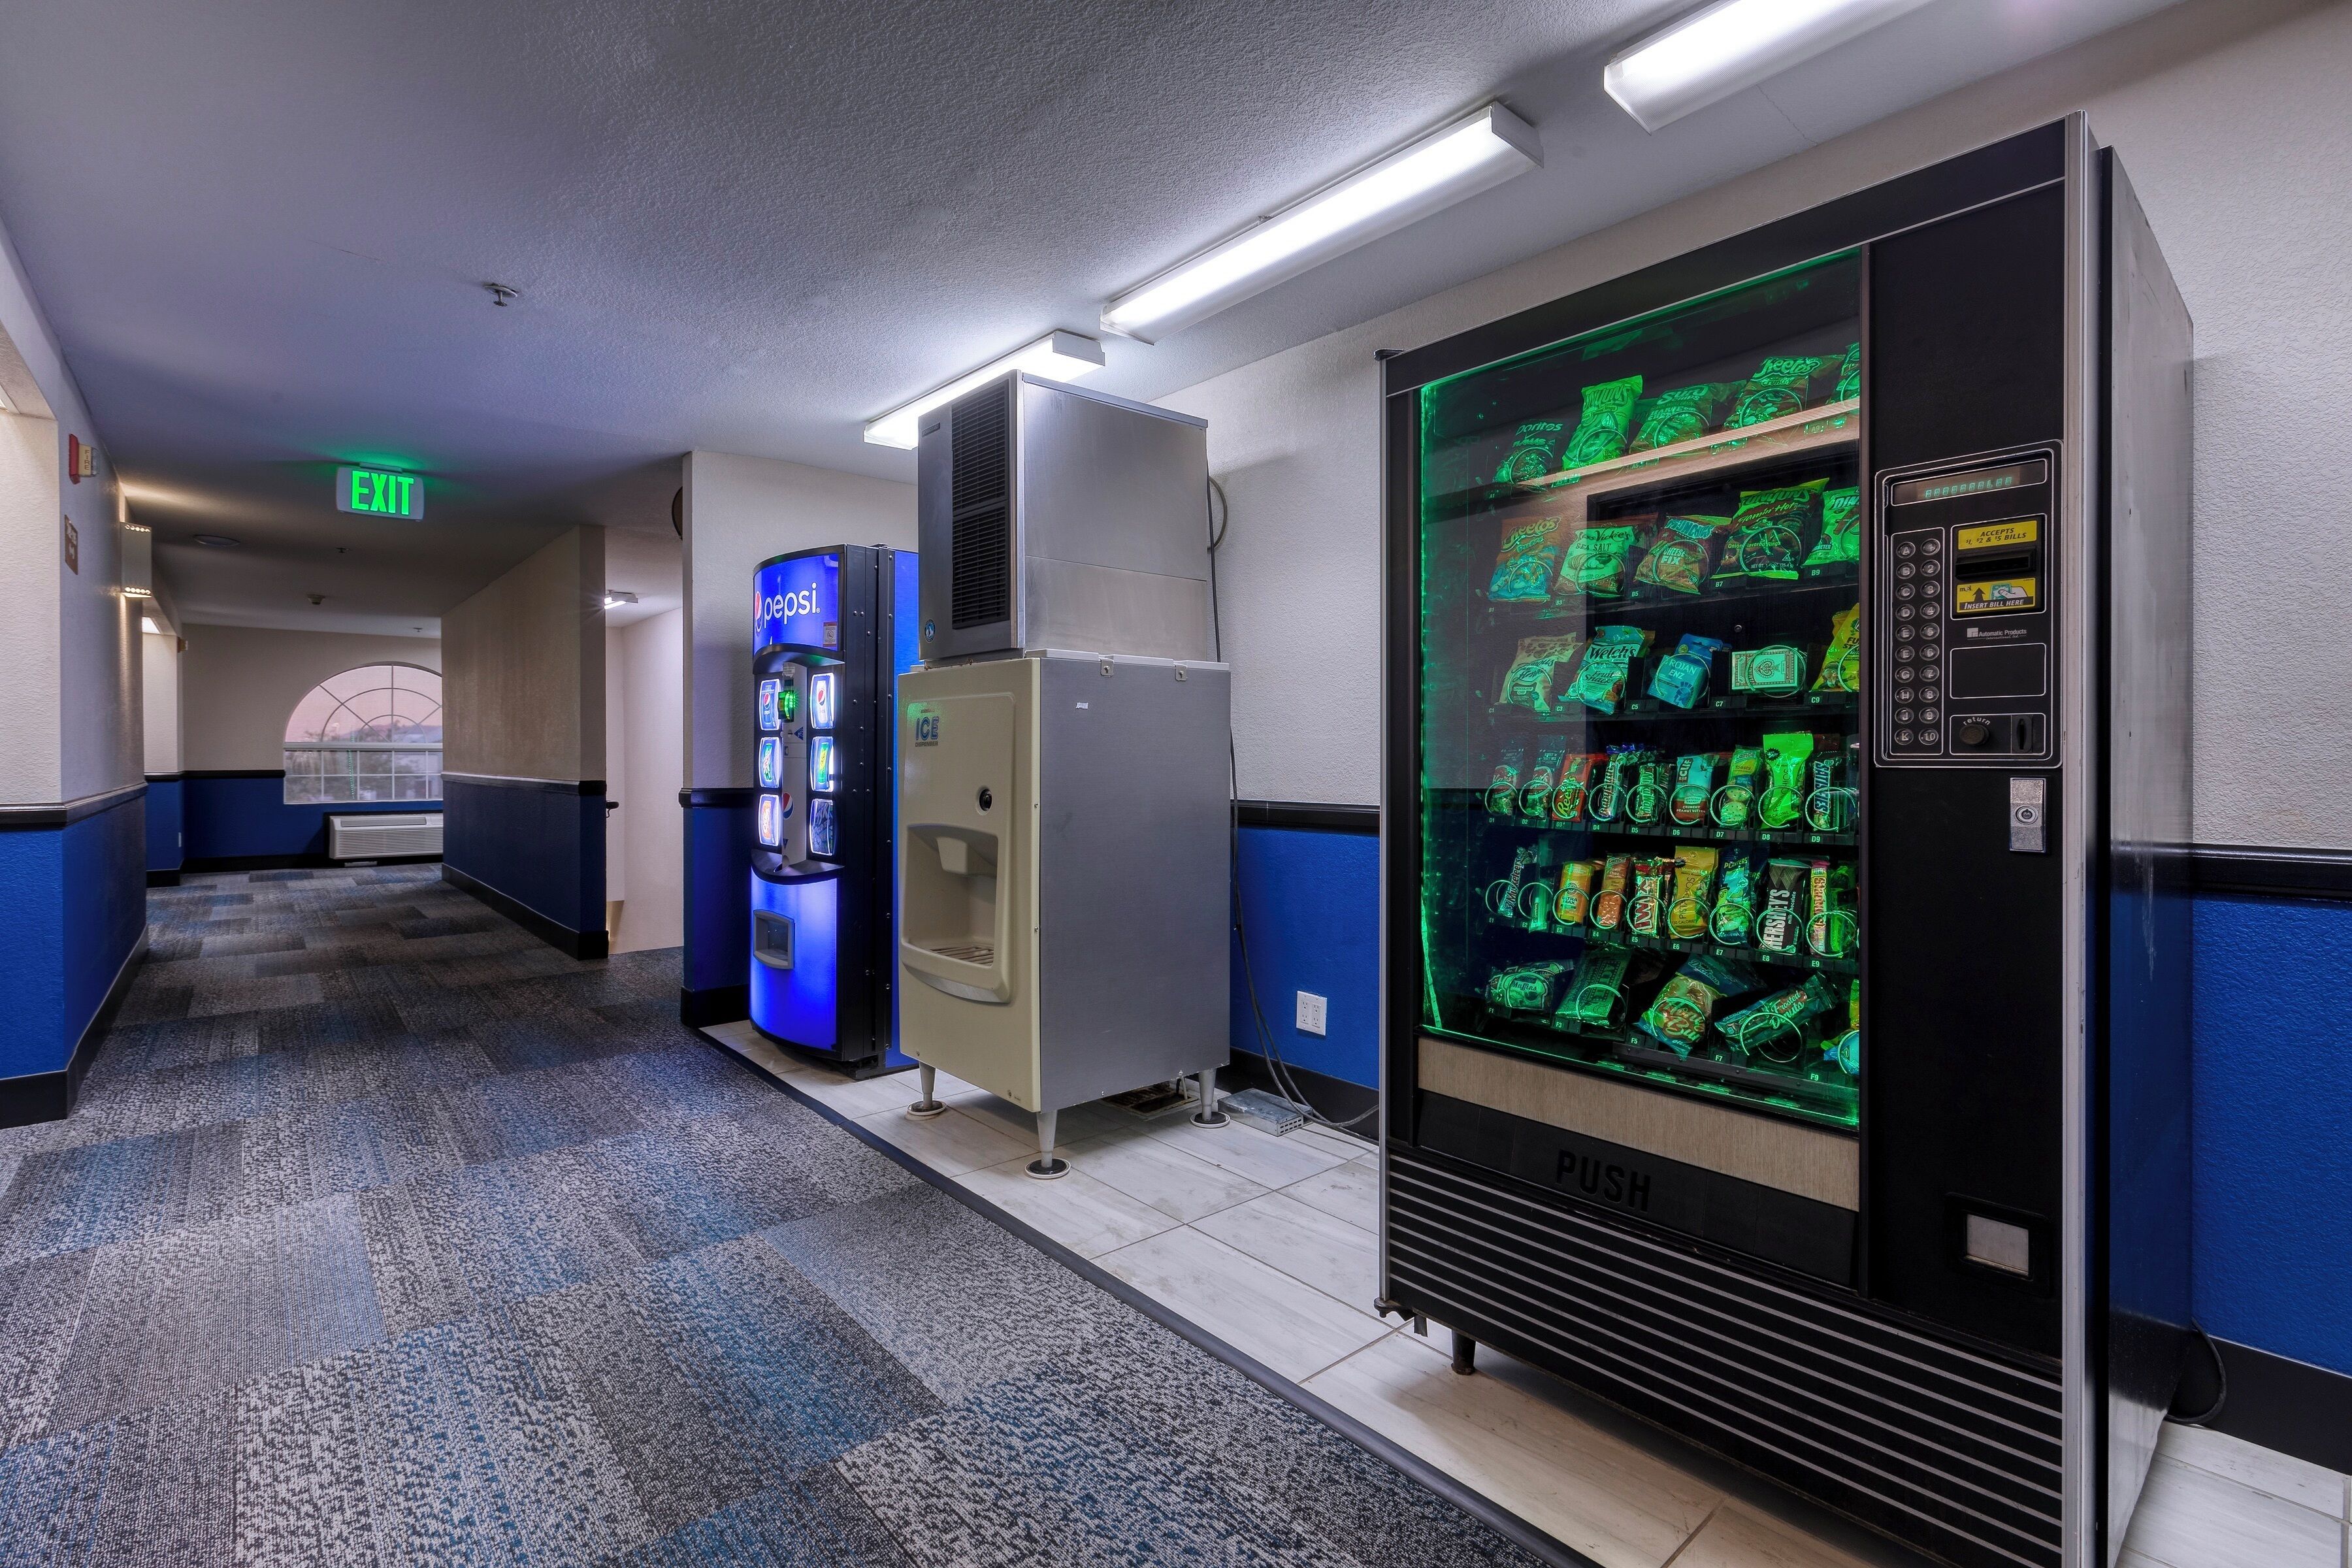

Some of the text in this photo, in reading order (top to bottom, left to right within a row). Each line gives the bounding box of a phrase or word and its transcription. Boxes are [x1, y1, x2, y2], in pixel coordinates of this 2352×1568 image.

[1516, 422, 1563, 435] Doritos
[352, 470, 414, 515] EXIT
[1775, 502, 1795, 512] Hot
[1595, 525, 1629, 542] Vickie's
[1980, 528, 2014, 536] ACCEPTS
[1660, 555, 1681, 564] FIX
[1663, 548, 1685, 557] CHEESE
[764, 582, 817, 629] pepsi
[1590, 645, 1637, 660] Welch's
[1669, 670, 1685, 679] ENZ
[1963, 716, 1991, 725] return
[915, 716, 939, 741] ICE
[1679, 758, 1691, 777] CLIF
[1724, 857, 1748, 869] PLANTERS
[1635, 878, 1651, 928] TWIX
[1512, 980, 1537, 990] Muffins
[1771, 990, 1801, 1013] Frosted
[1556, 1149, 1651, 1213] PUSH
